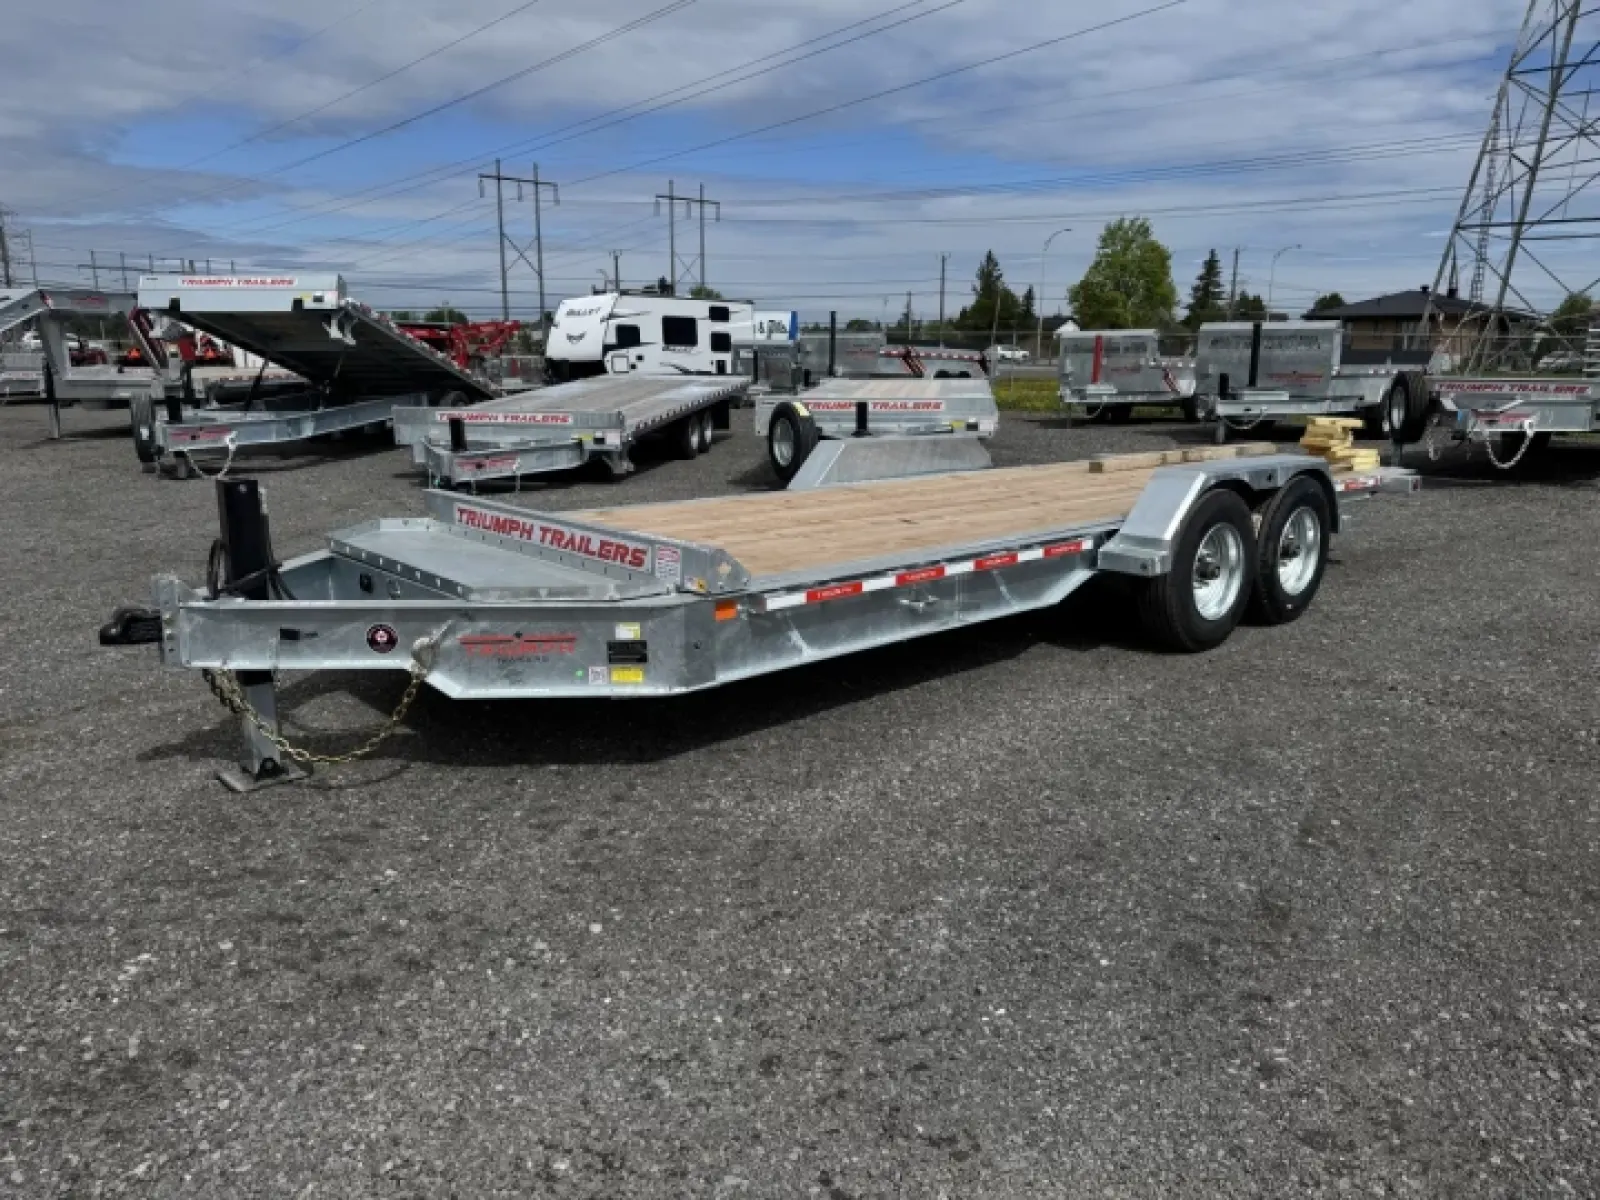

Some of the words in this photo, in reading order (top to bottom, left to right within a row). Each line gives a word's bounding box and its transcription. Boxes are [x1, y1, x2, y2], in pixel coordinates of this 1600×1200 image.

[504, 414, 570, 423] TRAILERS
[457, 507, 535, 540] TRIUMPH
[539, 526, 648, 568] TRAILERS
